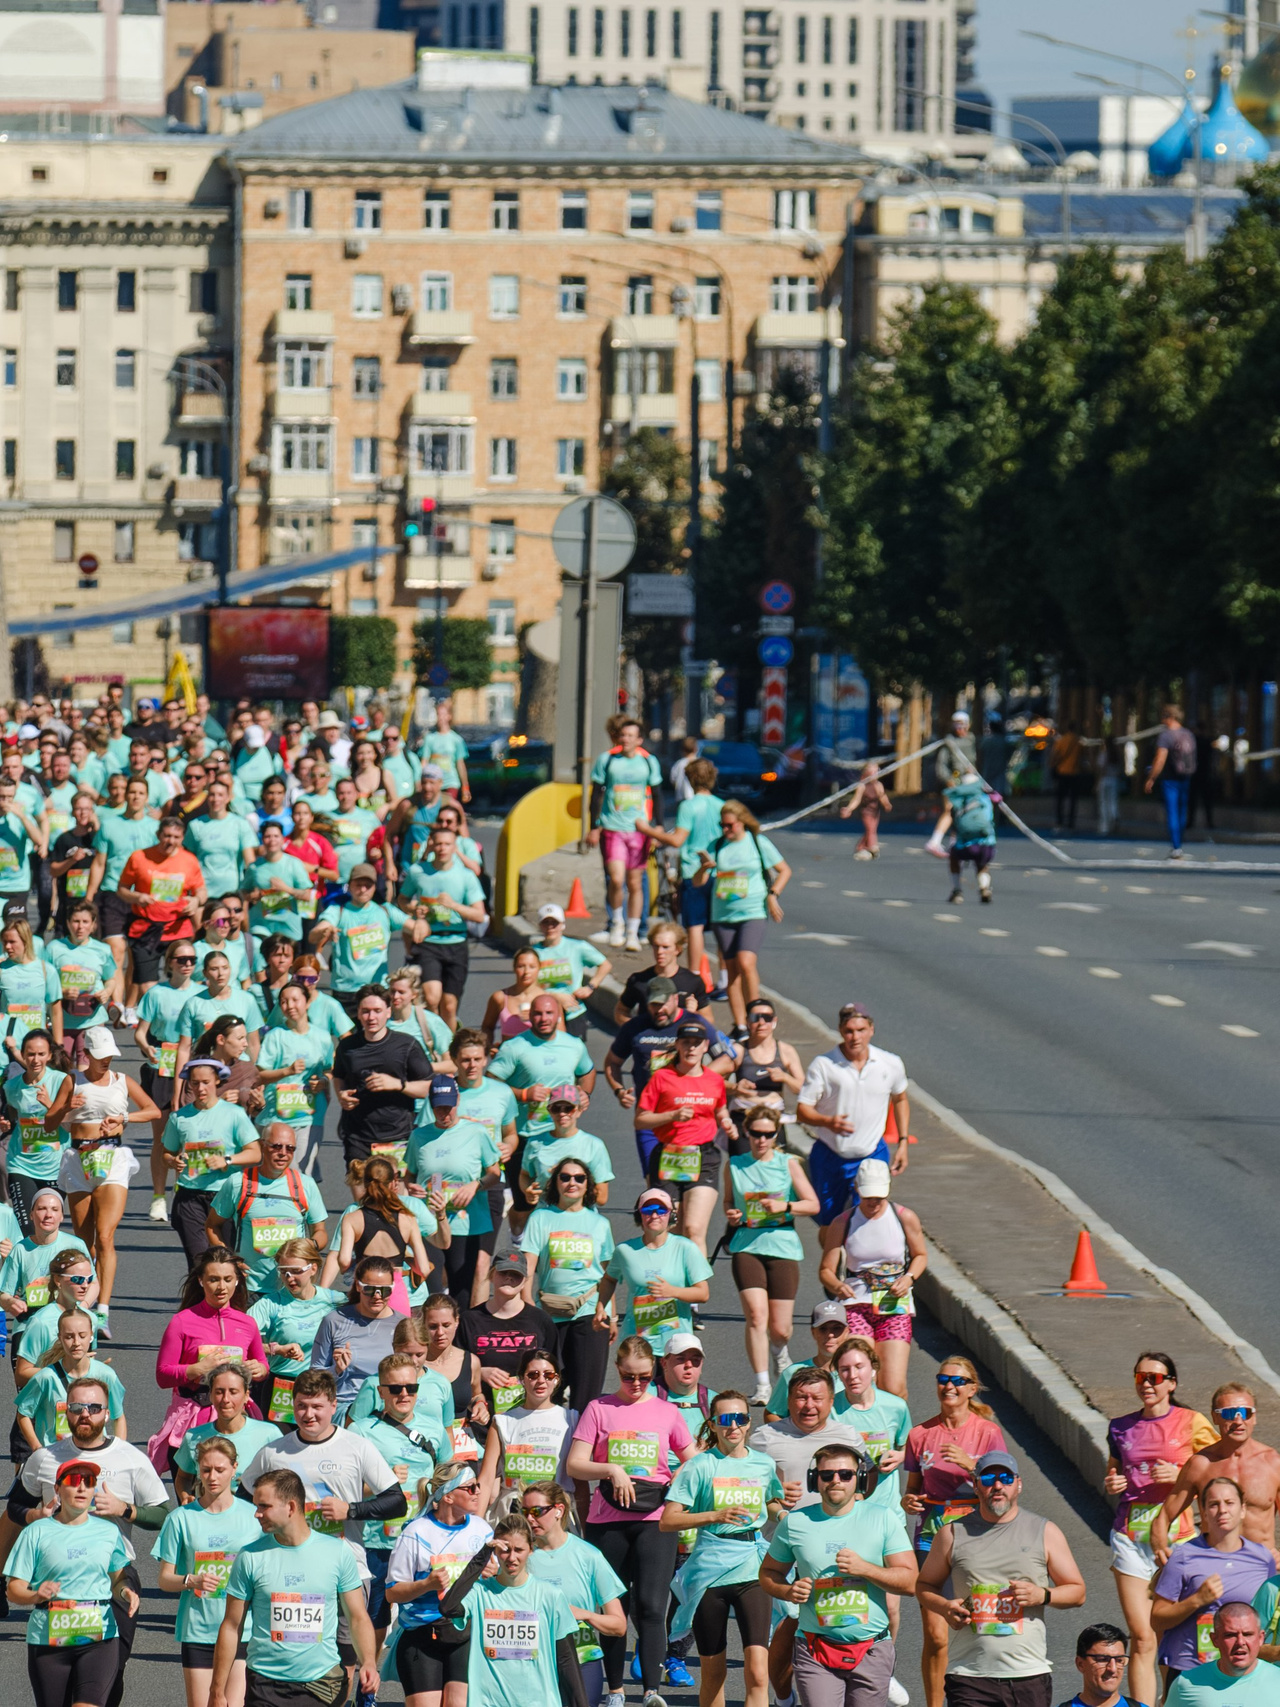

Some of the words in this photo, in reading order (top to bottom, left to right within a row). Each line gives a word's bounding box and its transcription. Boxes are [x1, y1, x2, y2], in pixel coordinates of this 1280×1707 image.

[82, 1152, 113, 1167] 65501
[662, 1153, 700, 1167] 77230
[255, 1228, 295, 1242] 68267
[551, 1239, 593, 1254] 71383
[634, 1299, 676, 1321] 77593
[476, 1335, 536, 1348] STAFF
[528, 1436, 551, 1445] CLUB
[610, 1442, 657, 1459] 68535
[506, 1456, 555, 1473] 68586
[715, 1488, 761, 1505] 76856
[973, 1597, 1021, 1614] 34259
[51, 1610, 101, 1630] 68222
[273, 1606, 322, 1624] 50154
[284, 1622, 312, 1630] ДМИТРИЙ
[486, 1623, 537, 1641] 50155
[492, 1639, 532, 1648] ЕКАТЕРИНА
